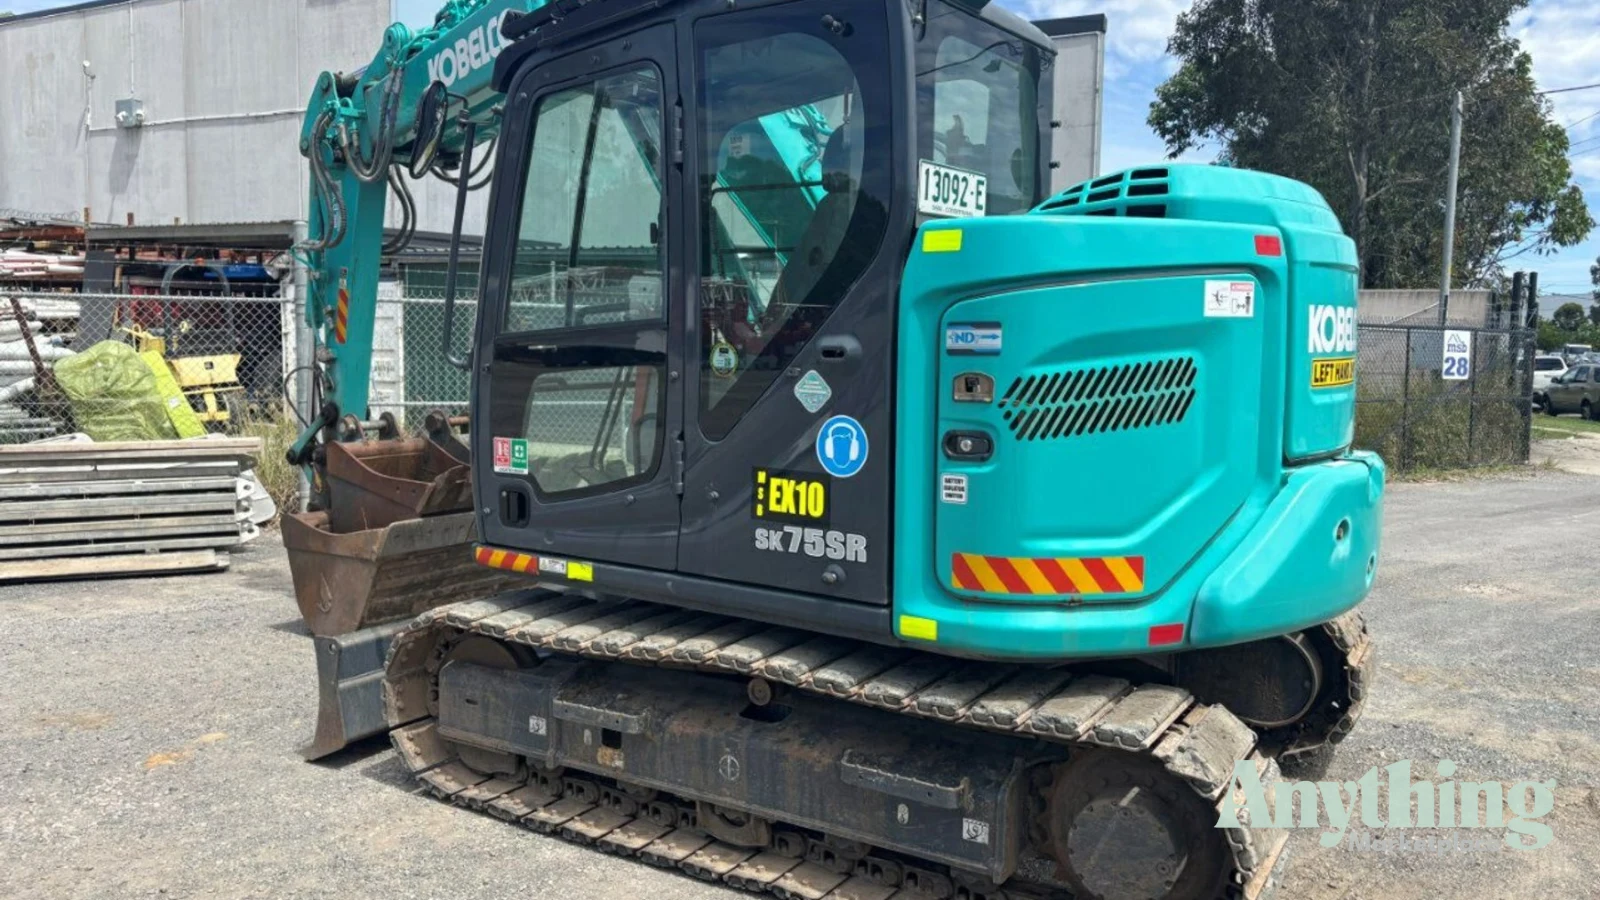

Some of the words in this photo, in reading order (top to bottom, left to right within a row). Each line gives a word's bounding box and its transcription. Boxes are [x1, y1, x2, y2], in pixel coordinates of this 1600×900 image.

[1313, 363, 1334, 384] LEFT
[1444, 356, 1468, 377] 28
[769, 477, 825, 517] EX10
[755, 525, 867, 563] SK75SR
